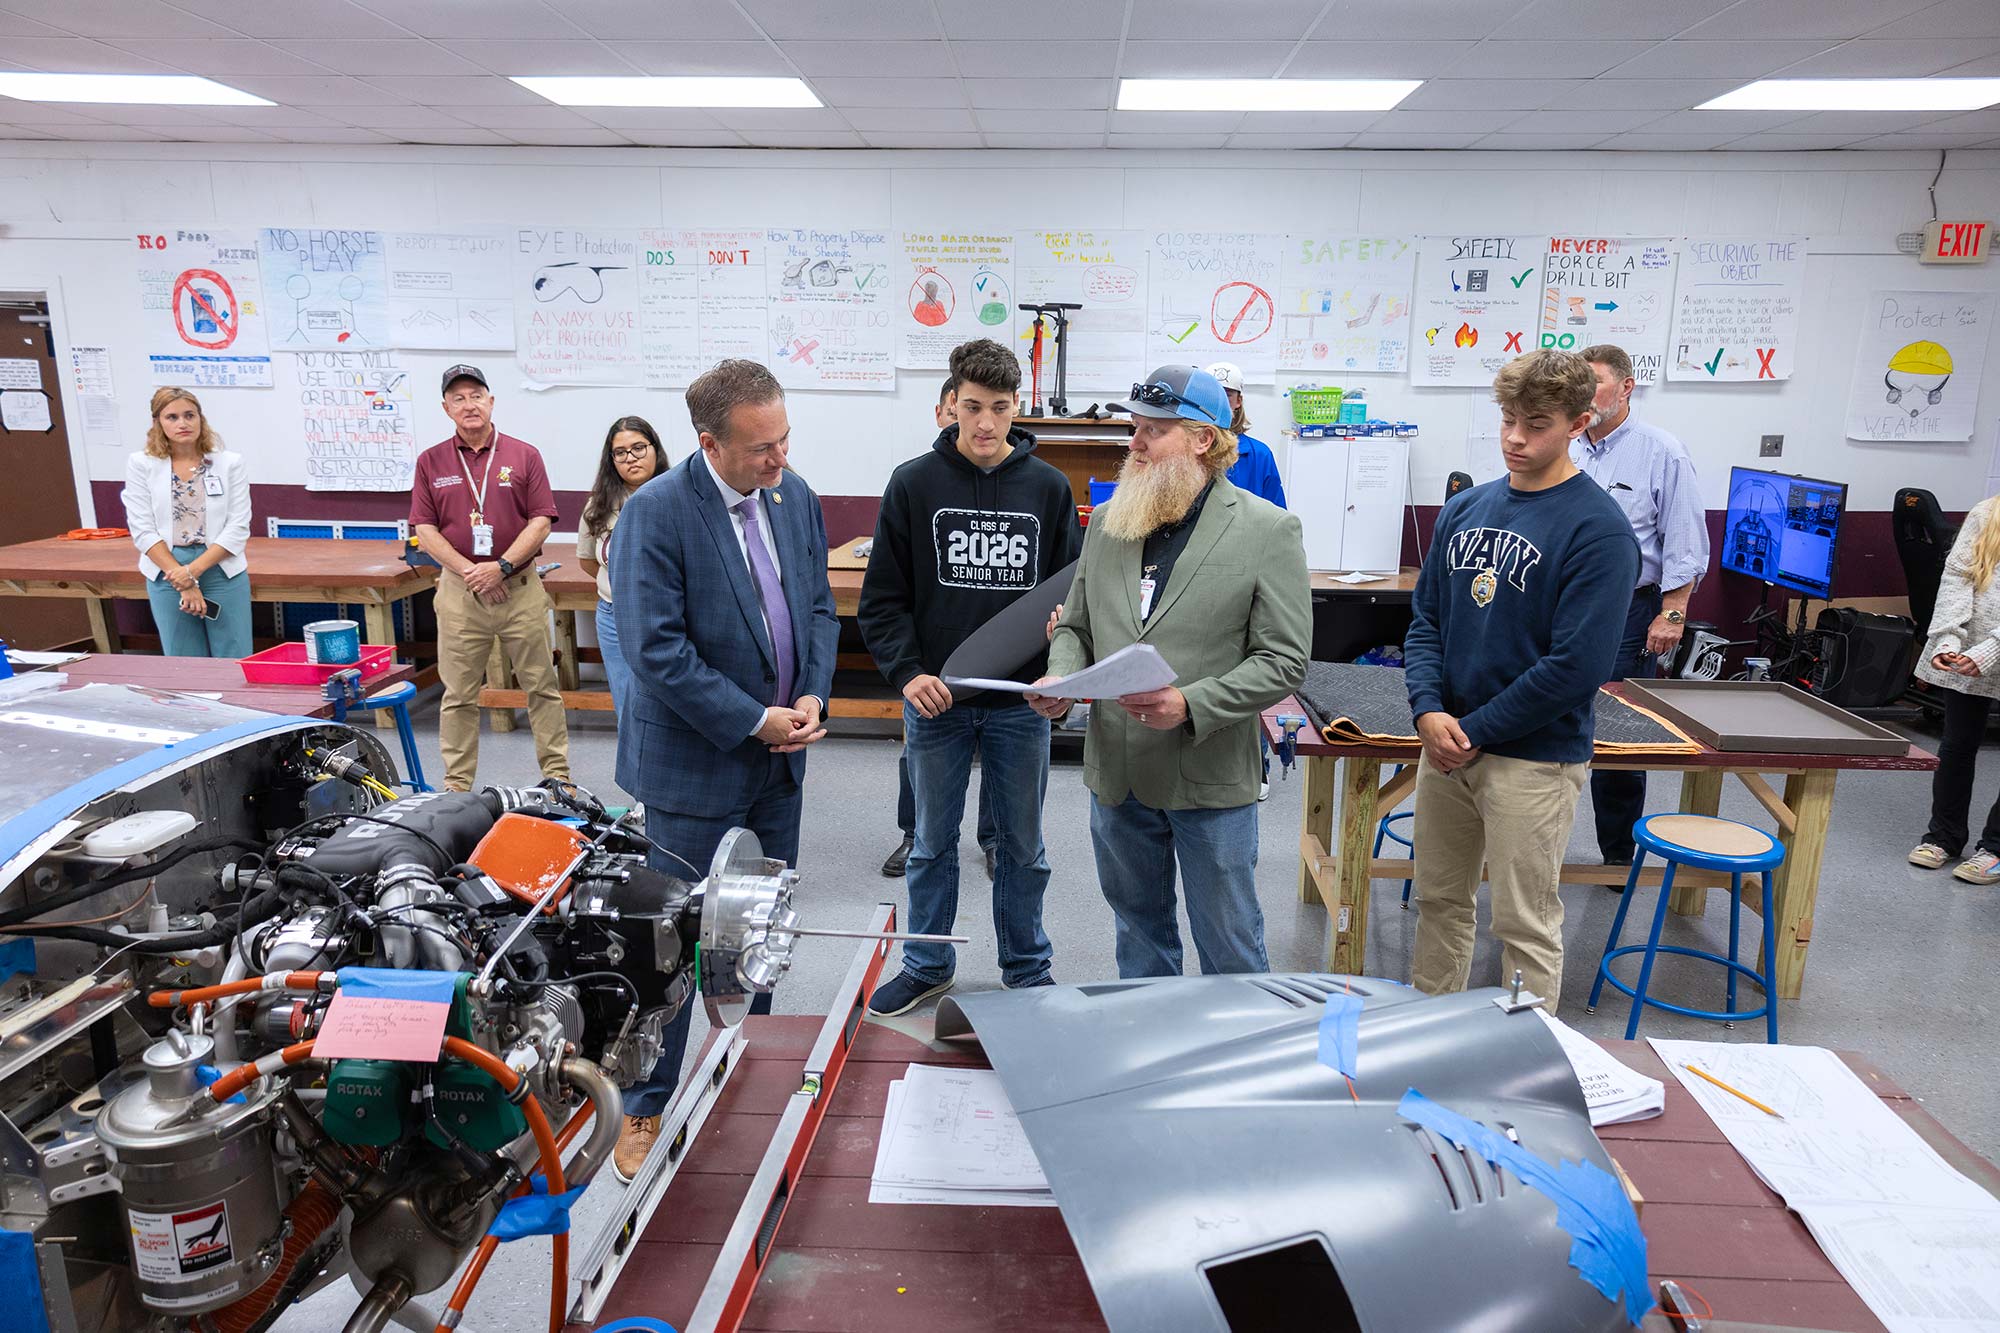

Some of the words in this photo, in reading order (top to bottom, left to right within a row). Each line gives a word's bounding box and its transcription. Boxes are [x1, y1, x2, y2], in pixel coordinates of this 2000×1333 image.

[137, 234, 167, 250] NO
[269, 229, 299, 252] NO
[308, 229, 378, 254] HORSE
[519, 230, 566, 254] EYE
[575, 231, 635, 255] Protection
[767, 229, 789, 242] How
[793, 229, 806, 242] To
[810, 229, 848, 249] Properly
[851, 230, 886, 250] Dispose
[902, 232, 934, 243] LONG
[941, 234, 970, 243] HAIR
[1155, 232, 1211, 246] Closed
[1937, 223, 1986, 257] EXIT
[786, 245, 808, 257] Metal
[1161, 248, 1203, 260] Shoes
[1231, 248, 1257, 261] the
[1300, 238, 1409, 265] SAFETY
[1452, 237, 1516, 259] SAFETY
[1691, 242, 1760, 266] SECURING
[1766, 242, 1797, 264] THE
[300, 249, 358, 273] PLAY
[646, 250, 676, 265] DO'S
[708, 249, 751, 266] DON'T
[1548, 255, 1607, 270] FORCE
[1622, 255, 1636, 270] A
[1546, 271, 1598, 288] DRILL
[1605, 271, 1631, 289] BIT
[1720, 264, 1762, 280] OBJECT
[870, 276, 889, 288] DO
[531, 311, 596, 328] ALWAYS
[604, 311, 635, 329] USE
[801, 309, 825, 328] DO
[831, 310, 862, 328] NOT
[867, 310, 890, 328] DO
[1878, 298, 1947, 329] Protect
[527, 329, 553, 346] EYE
[820, 329, 857, 346] THIS
[295, 351, 317, 367] NO
[323, 351, 353, 369] ONE
[360, 351, 399, 370] WILL
[1630, 355, 1662, 368] TANT
[298, 371, 329, 387] USE
[334, 370, 384, 388] TOOLS
[1633, 368, 1657, 381] URE
[302, 390, 321, 406] OR
[323, 390, 366, 406] BUILD
[304, 418, 324, 434] ON
[325, 418, 356, 434] THE
[357, 418, 406, 434] PLANE
[1864, 416, 1921, 435] WEAR
[1921, 417, 1942, 434] THE
[306, 441, 370, 457] WITHOUT
[371, 441, 403, 457] THE
[970, 520, 997, 532] CLASS
[999, 521, 1011, 533] OF
[947, 529, 1029, 569] 2026
[1447, 527, 1542, 592] NAVY
[952, 565, 992, 581] SENIOR
[997, 568, 1025, 582] YEAR
[336, 1082, 383, 1100] ROTAX
[439, 1089, 486, 1104] ROTAX
[1584, 1088, 1625, 1100] SECTIO
[182, 1258, 193, 1266] Do
[194, 1256, 206, 1264] not
[208, 1247, 229, 1261] touch
